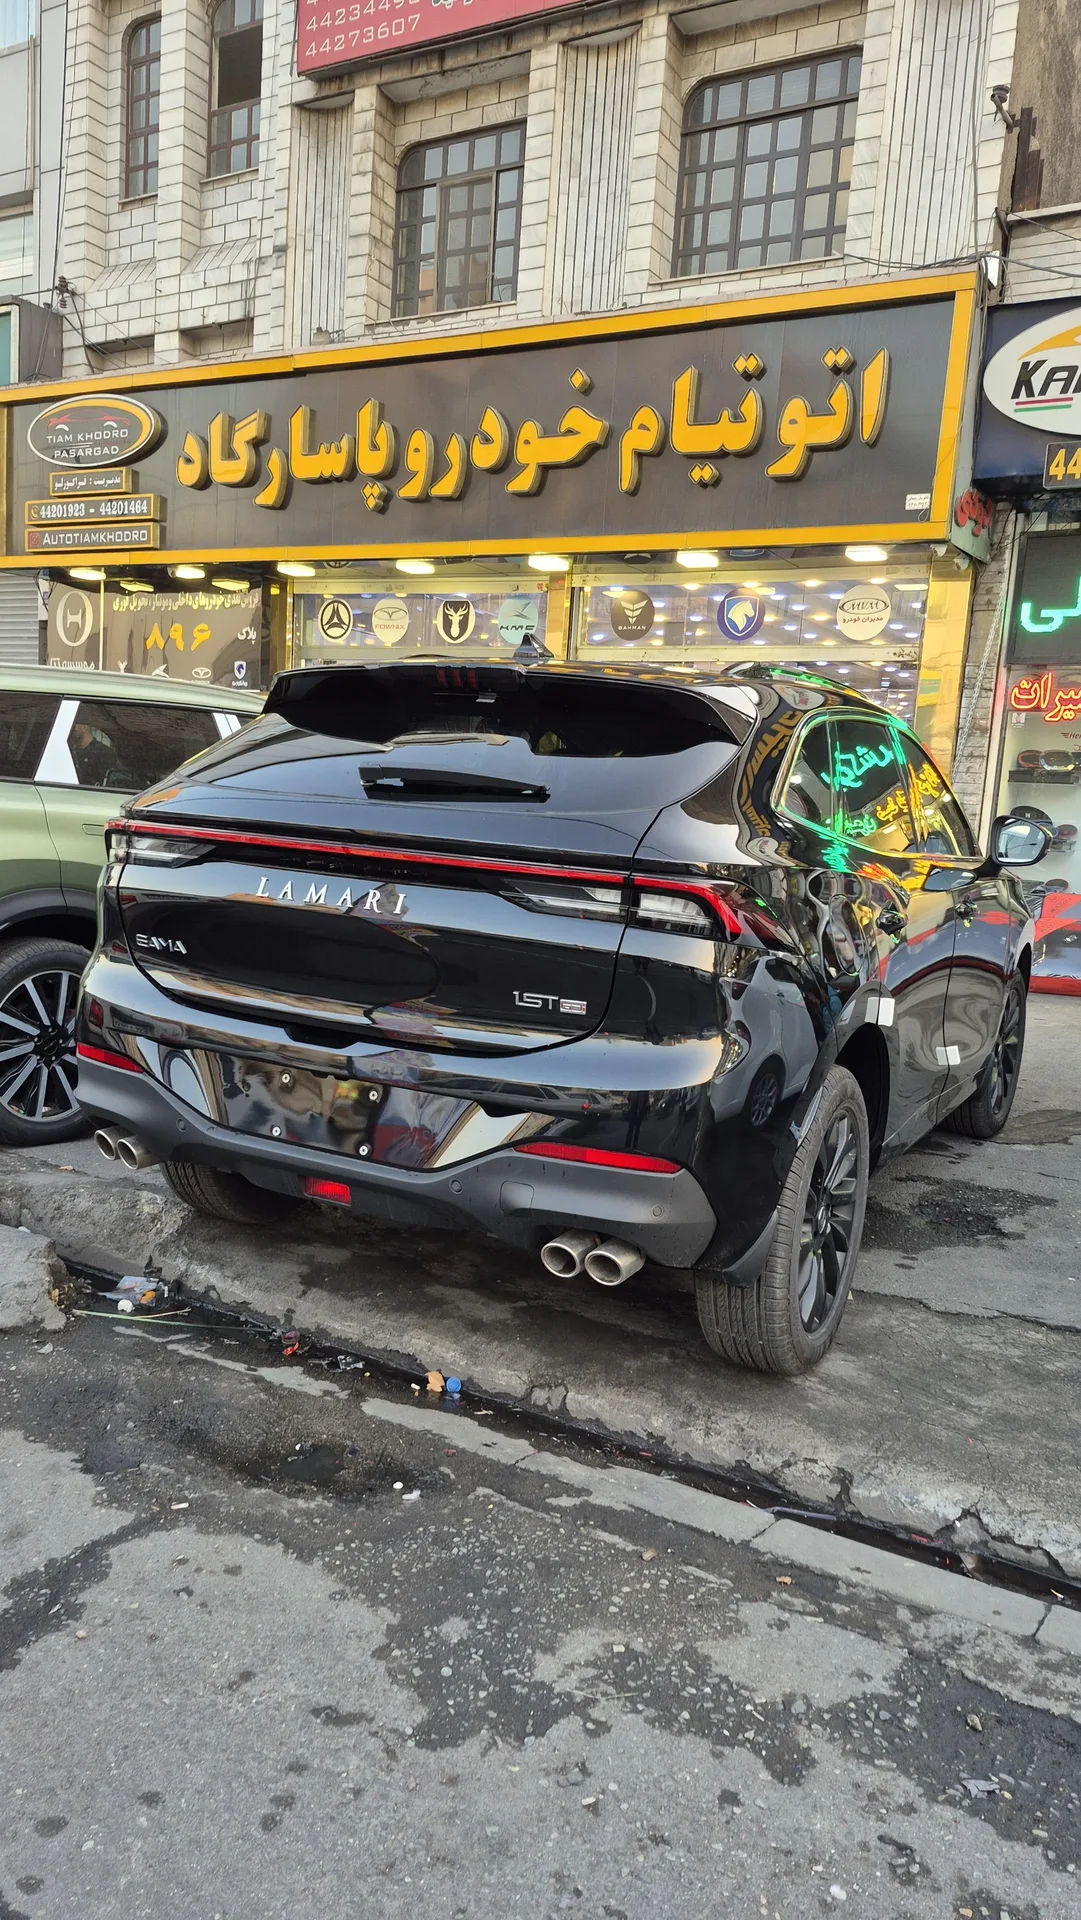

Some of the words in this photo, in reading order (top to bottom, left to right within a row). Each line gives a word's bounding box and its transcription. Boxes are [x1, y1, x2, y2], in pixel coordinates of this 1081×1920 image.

[305, 13, 421, 57] 44273607
[1011, 359, 1081, 399] KA
[766, 345, 889, 479] اتو
[396, 367, 609, 501] خودرو
[619, 352, 764, 495] تیام
[46, 434, 73, 444] TIAM
[77, 428, 128, 441] KHODRO
[54, 445, 119, 459] PASARGAD
[175, 397, 395, 512] پاسارگاد
[93, 476, 121, 488] مدیریت
[39, 502, 85, 518] 44201923
[99, 500, 148, 516] 44201464
[375, 623, 405, 631] FOWNIX
[617, 624, 647, 632] BAHMAN
[842, 616, 861, 624] خودرو
[237, 625, 257, 645] پلاک
[255, 876, 407, 915] LAMARI
[135, 933, 188, 955] EAMA
